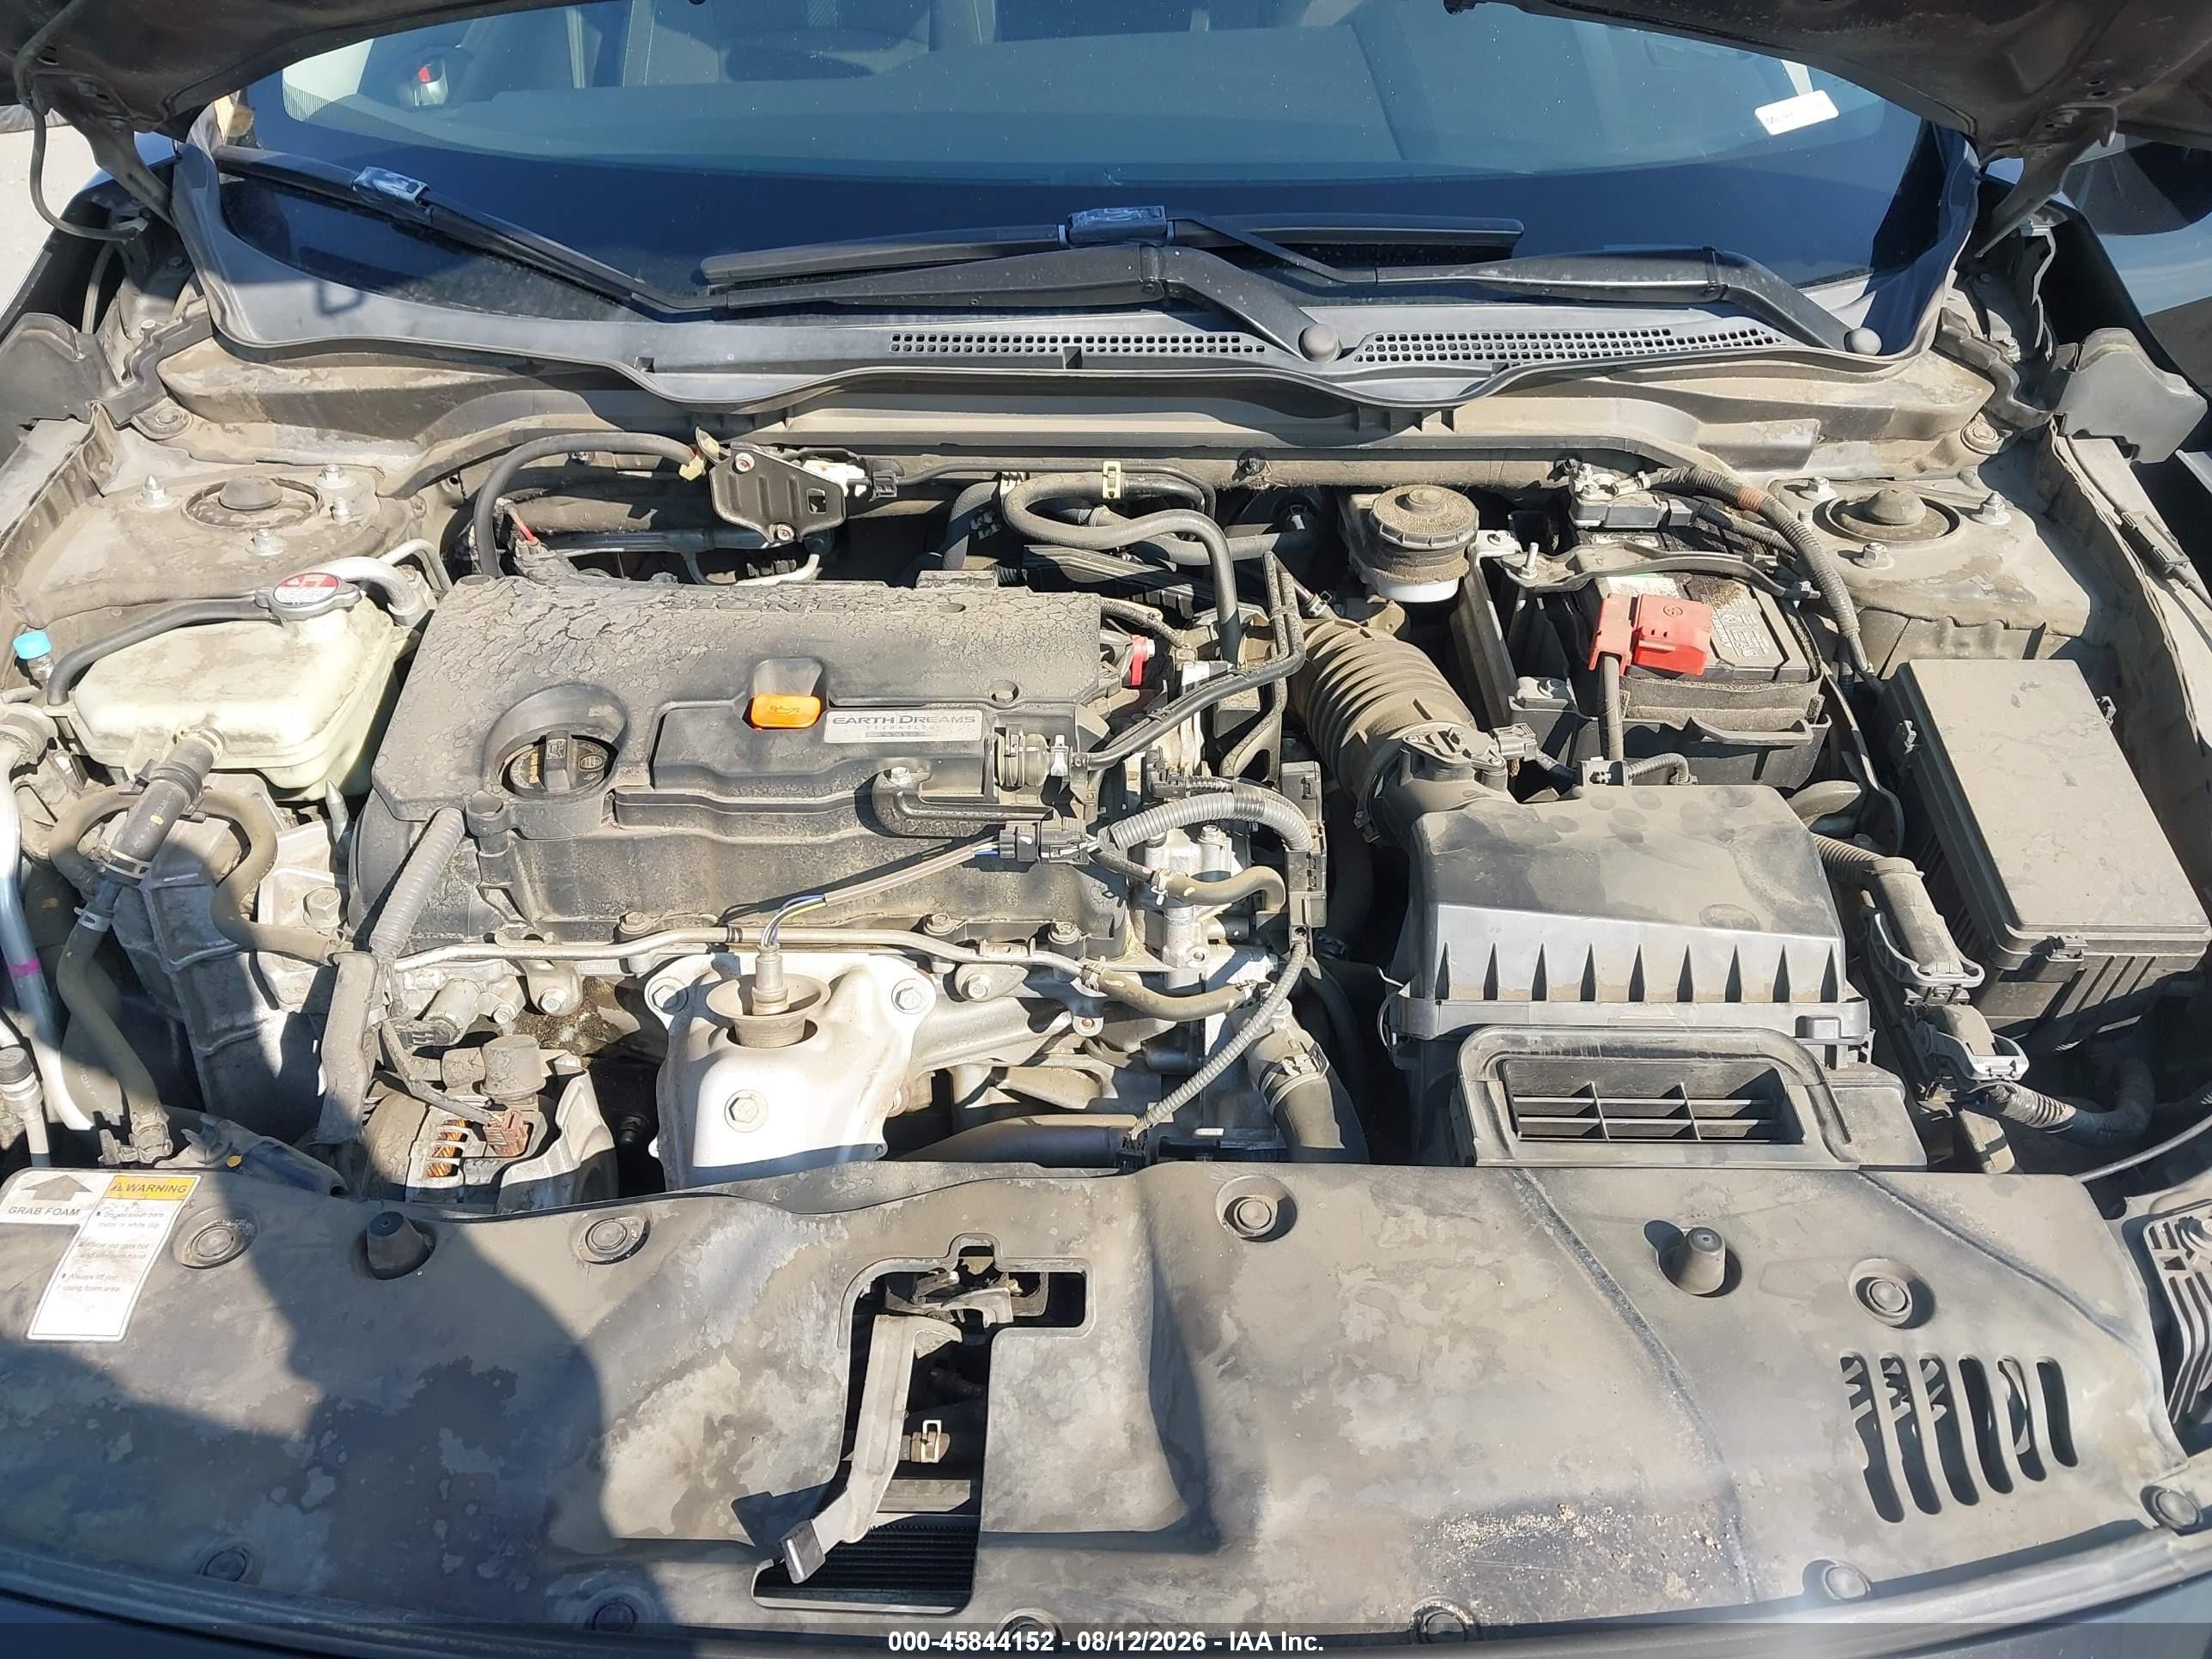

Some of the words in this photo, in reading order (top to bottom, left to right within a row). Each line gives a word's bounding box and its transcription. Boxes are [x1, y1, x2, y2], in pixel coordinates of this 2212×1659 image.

[832, 716, 895, 725] EARTH
[899, 714, 976, 725] DREAMS
[125, 1182, 188, 1194] WARNING
[8, 1206, 42, 1217] GRAB
[44, 1206, 81, 1218] FOAM
